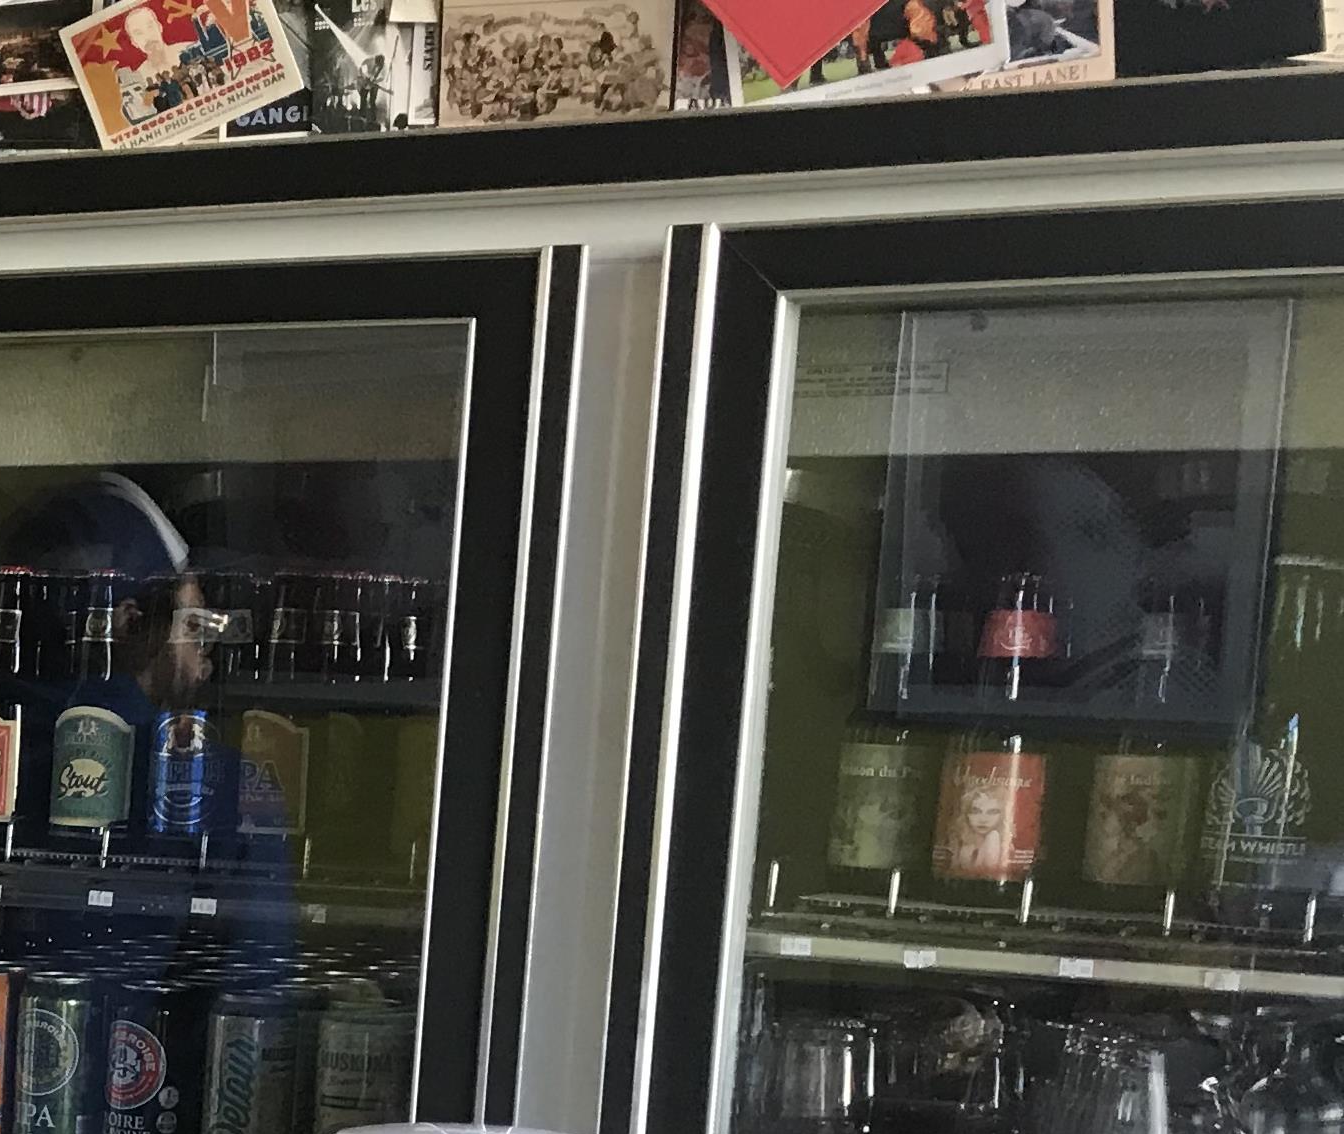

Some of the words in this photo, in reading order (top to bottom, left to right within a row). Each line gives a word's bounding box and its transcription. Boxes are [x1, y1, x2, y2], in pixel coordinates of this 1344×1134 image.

[224, 38, 274, 72] 1982
[57, 763, 109, 801] Stout
[1239, 840, 1307, 858] WHISTLE
